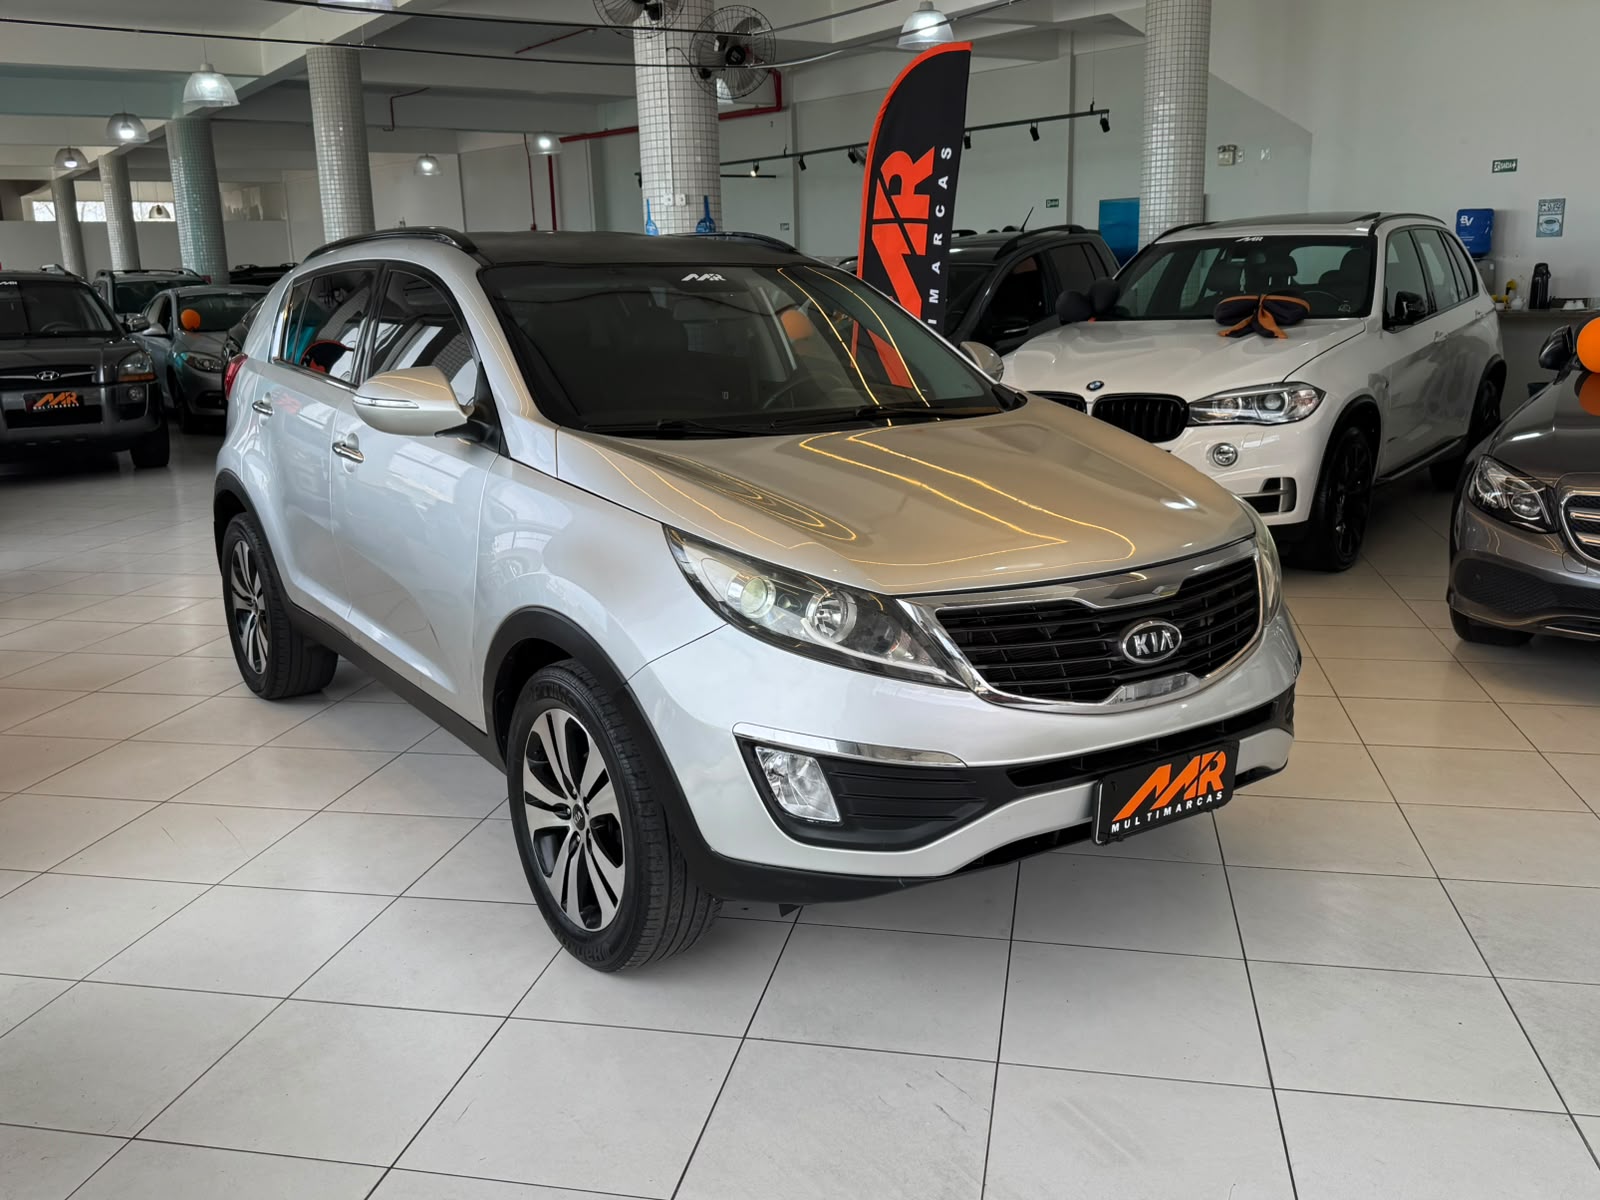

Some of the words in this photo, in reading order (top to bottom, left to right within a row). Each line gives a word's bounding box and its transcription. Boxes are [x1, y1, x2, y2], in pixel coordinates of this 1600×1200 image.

[927, 146, 952, 325] IMARCAS
[1133, 629, 1174, 656] KIA
[1111, 791, 1223, 833] MULTIMARCAS
[1112, 751, 1227, 822] MR
